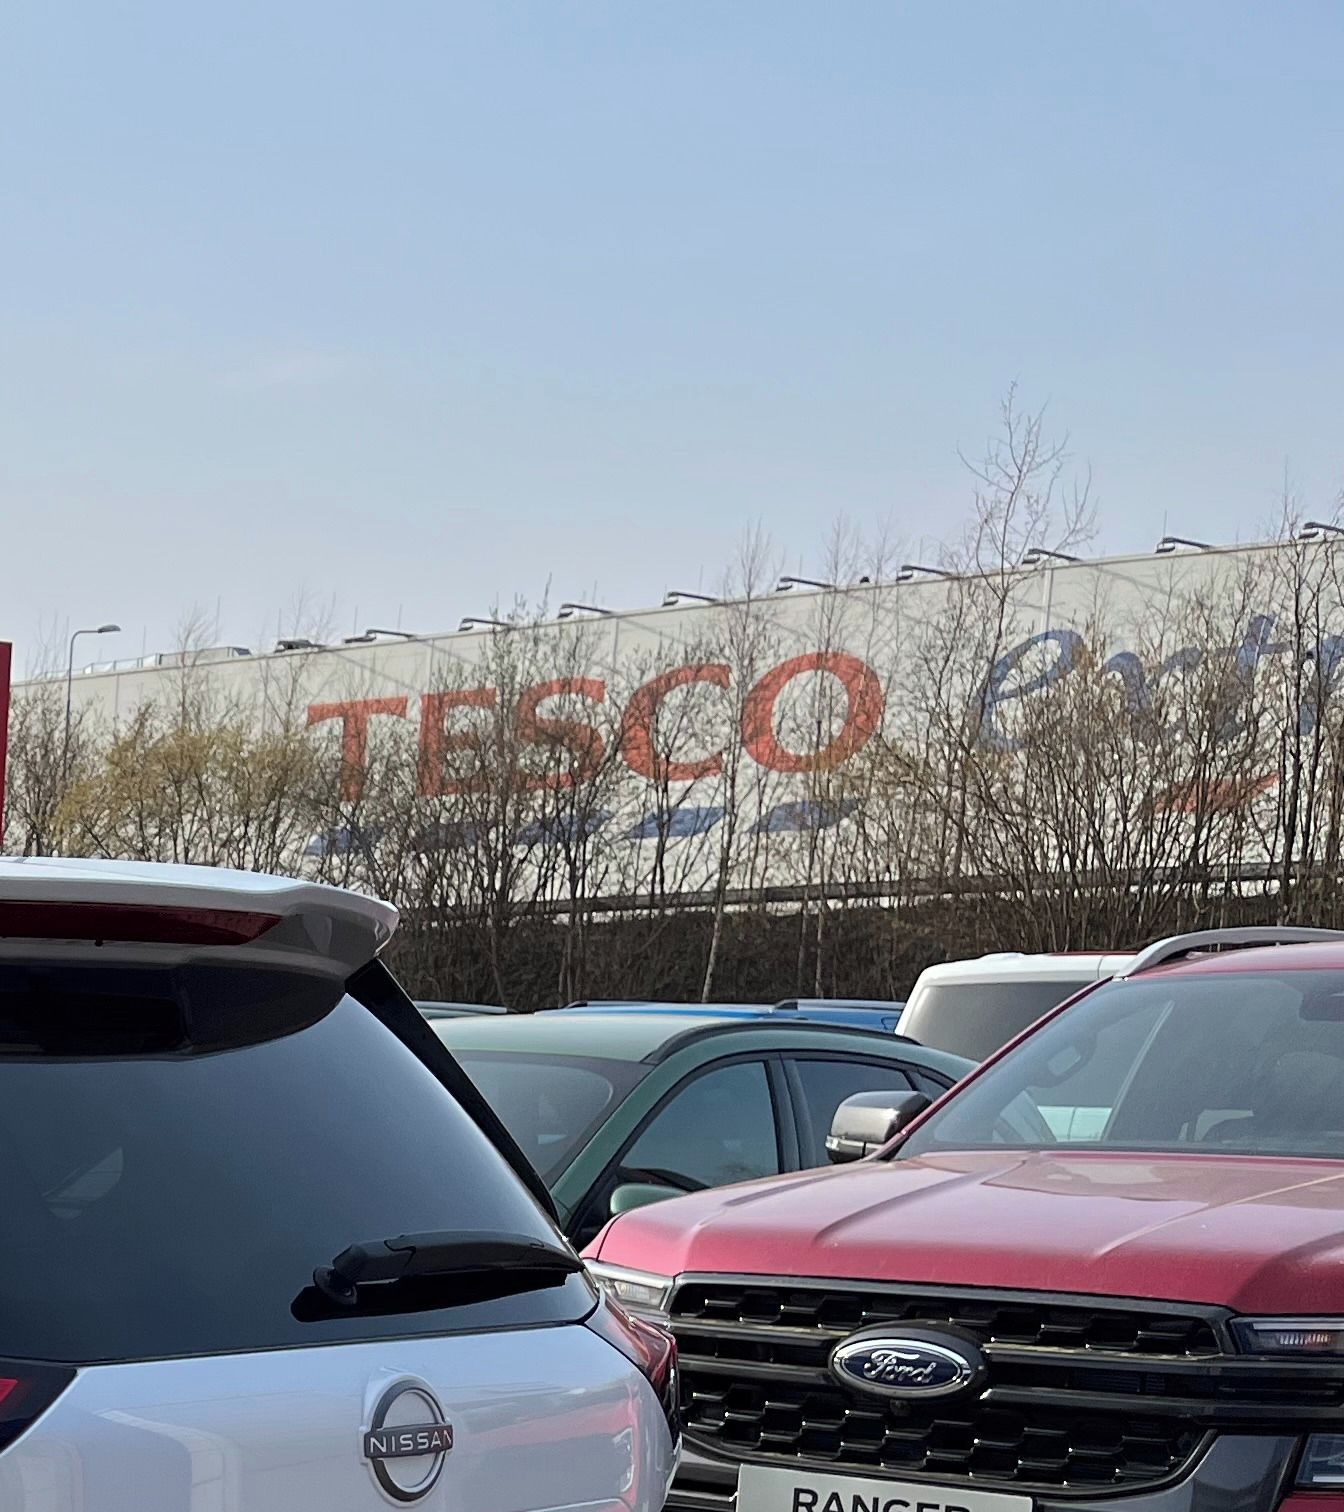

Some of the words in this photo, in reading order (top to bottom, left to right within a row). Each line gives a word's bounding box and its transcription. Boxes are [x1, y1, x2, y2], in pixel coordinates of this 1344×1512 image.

[307, 651, 883, 802] TESCO
[863, 1349, 938, 1384] Ford
[370, 1429, 453, 1454] NISSAN
